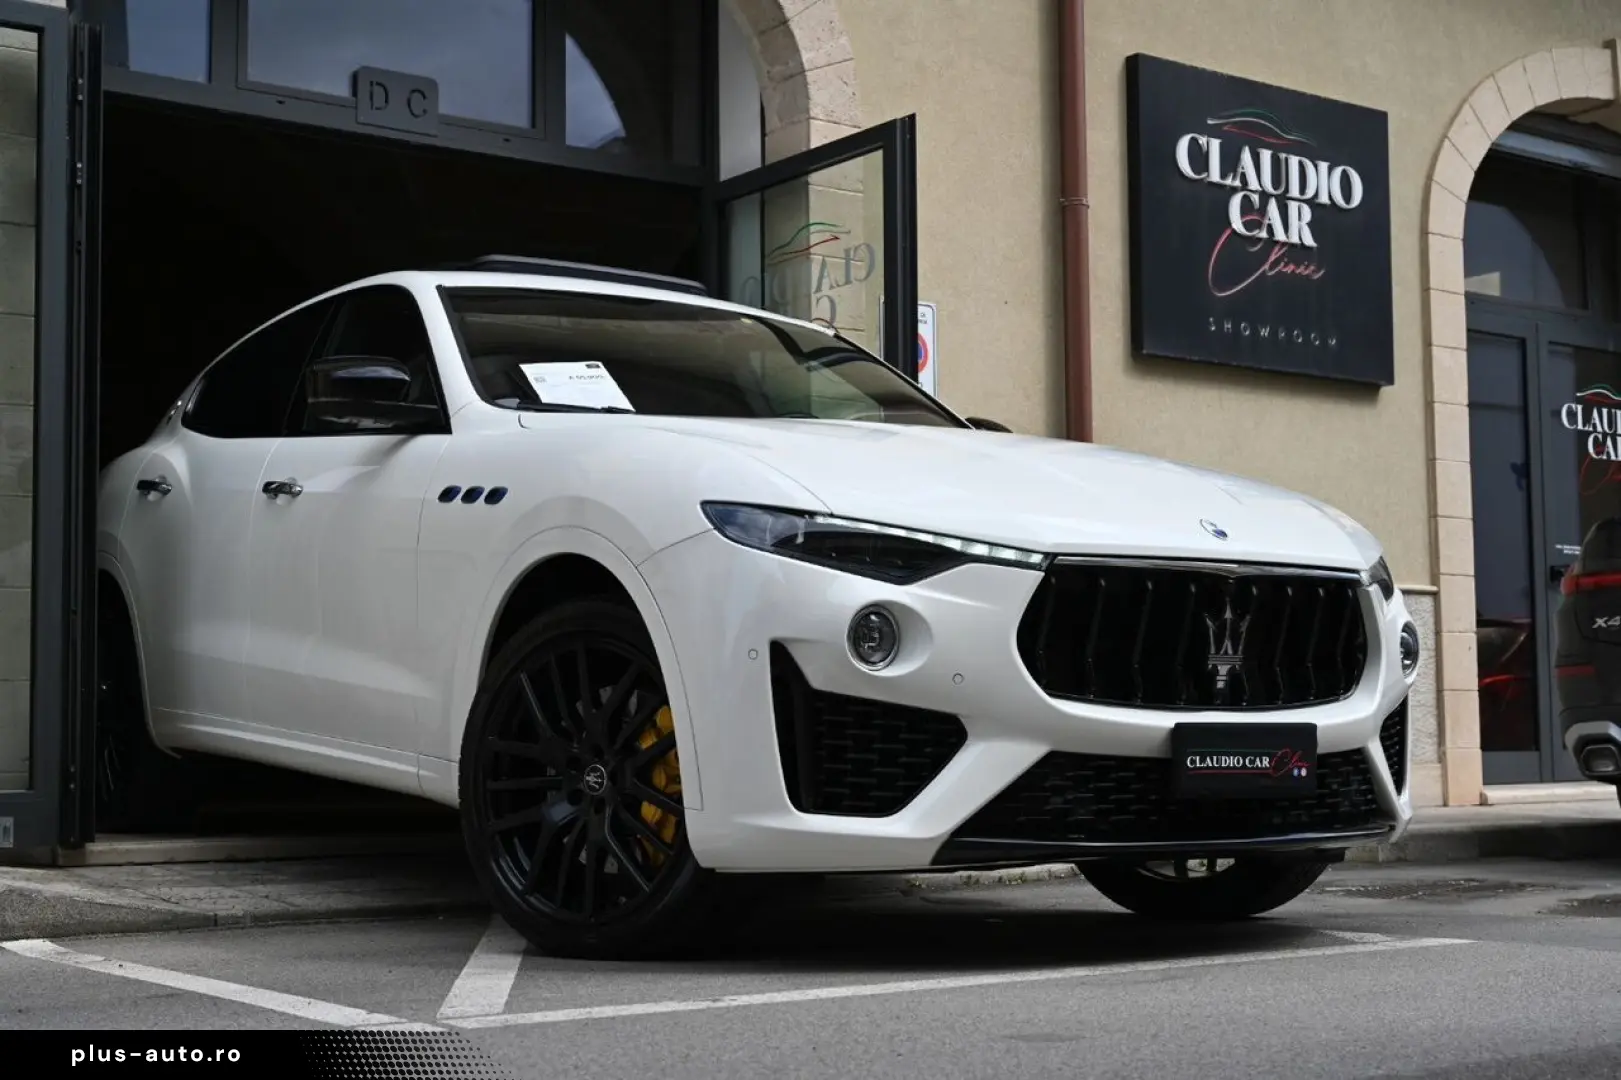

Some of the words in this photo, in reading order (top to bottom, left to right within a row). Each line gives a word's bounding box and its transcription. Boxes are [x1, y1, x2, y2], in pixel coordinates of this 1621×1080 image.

[1175, 132, 1364, 210] CLAUDIO
[1228, 190, 1318, 248] CAR
[1208, 213, 1326, 296] Clinic
[1207, 316, 1338, 347] SHOWROOM
[1591, 616, 1621, 629] X4
[1186, 755, 1243, 768] CLAUDIO
[1245, 756, 1270, 768] CAR
